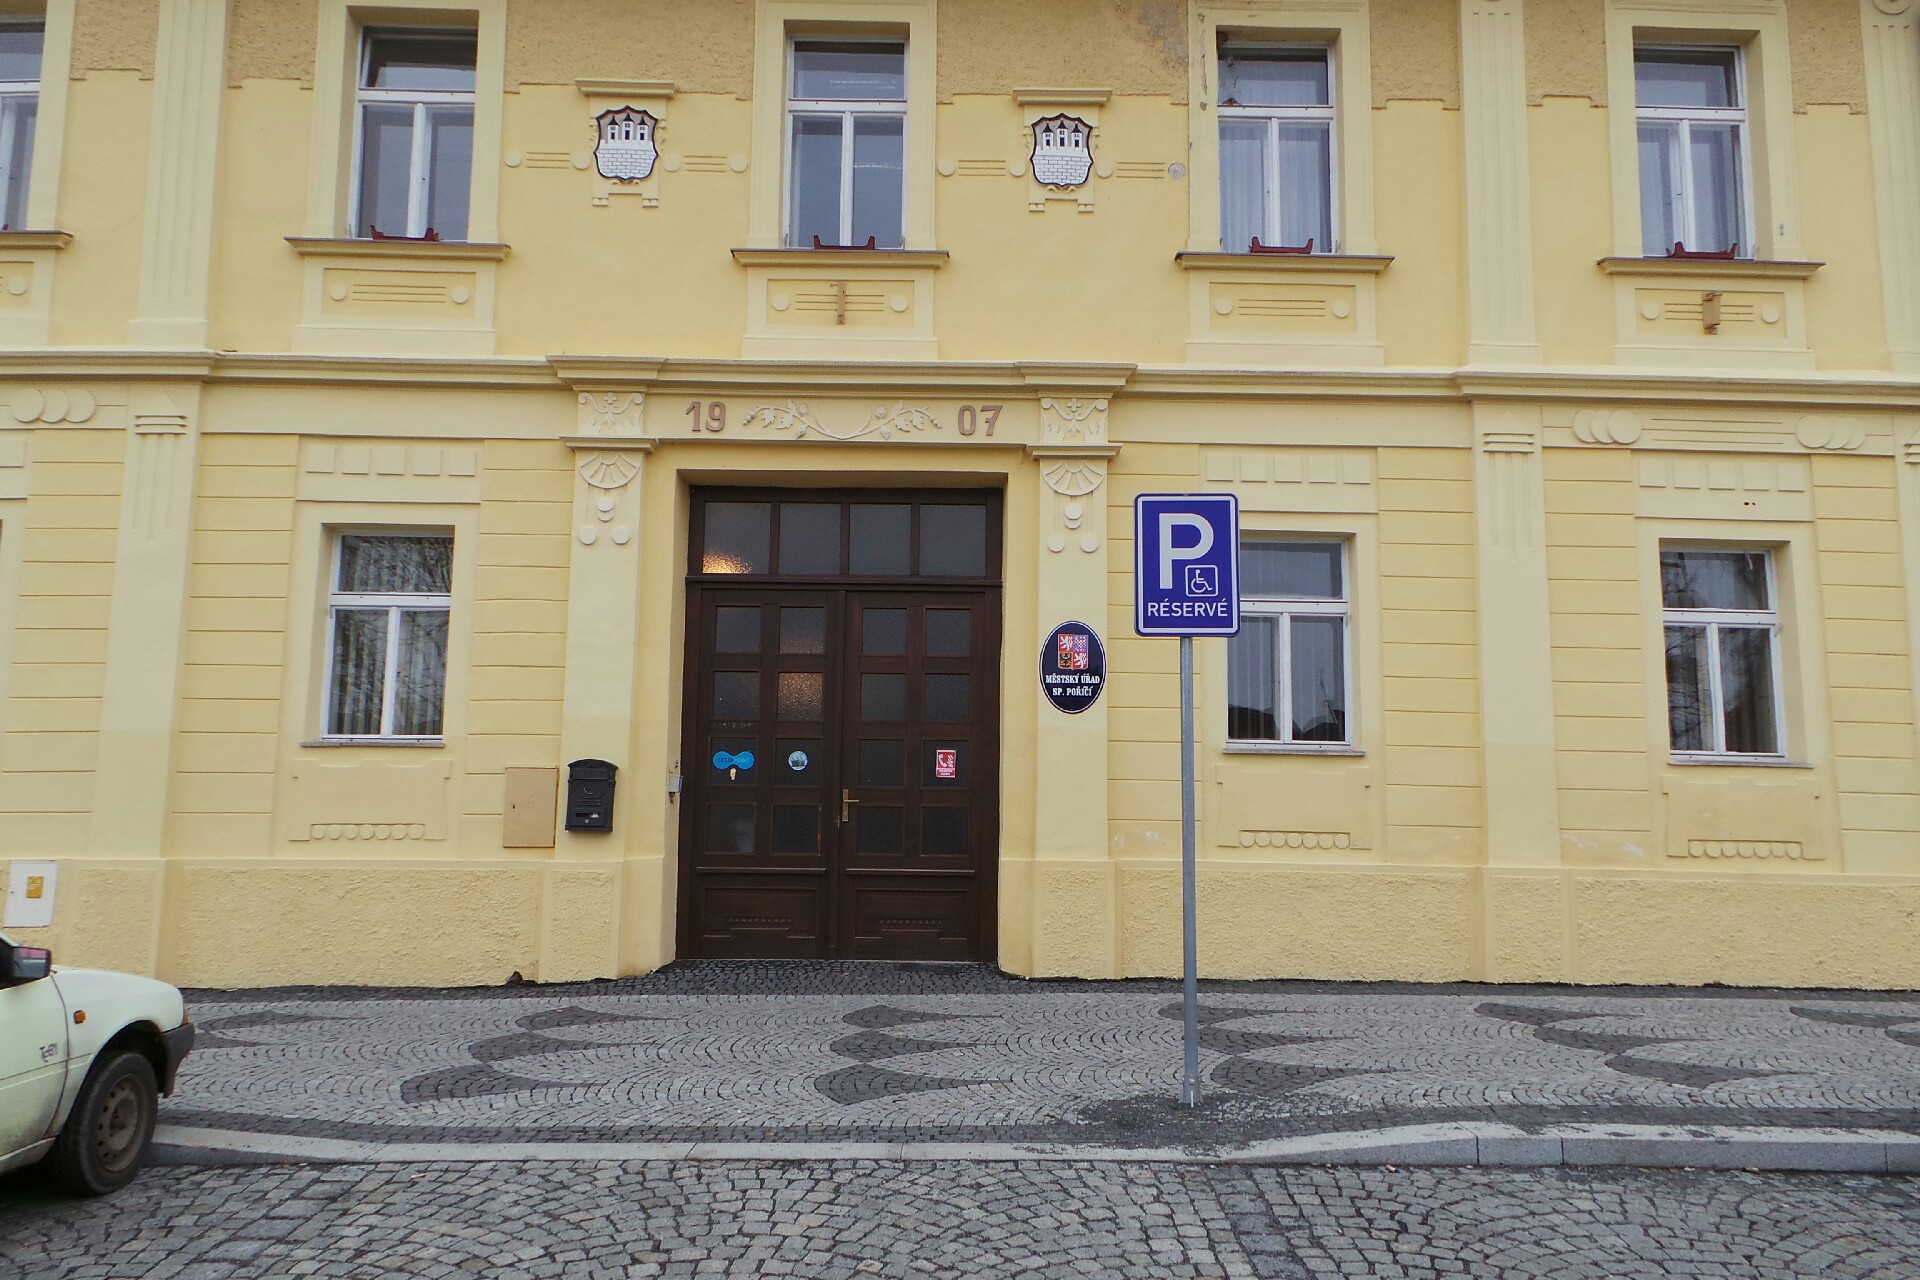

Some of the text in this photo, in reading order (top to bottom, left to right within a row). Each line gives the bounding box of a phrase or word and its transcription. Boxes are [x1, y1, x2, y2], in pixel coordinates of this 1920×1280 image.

[684, 401, 1004, 437] 19 07
[1158, 512, 1214, 590] P
[1147, 598, 1228, 617] RÉSERVÉ
[1045, 672, 1101, 684] MĚSTSKÝ ÚŘAD
[1052, 685, 1094, 697] SP. POŘÍČÍ
